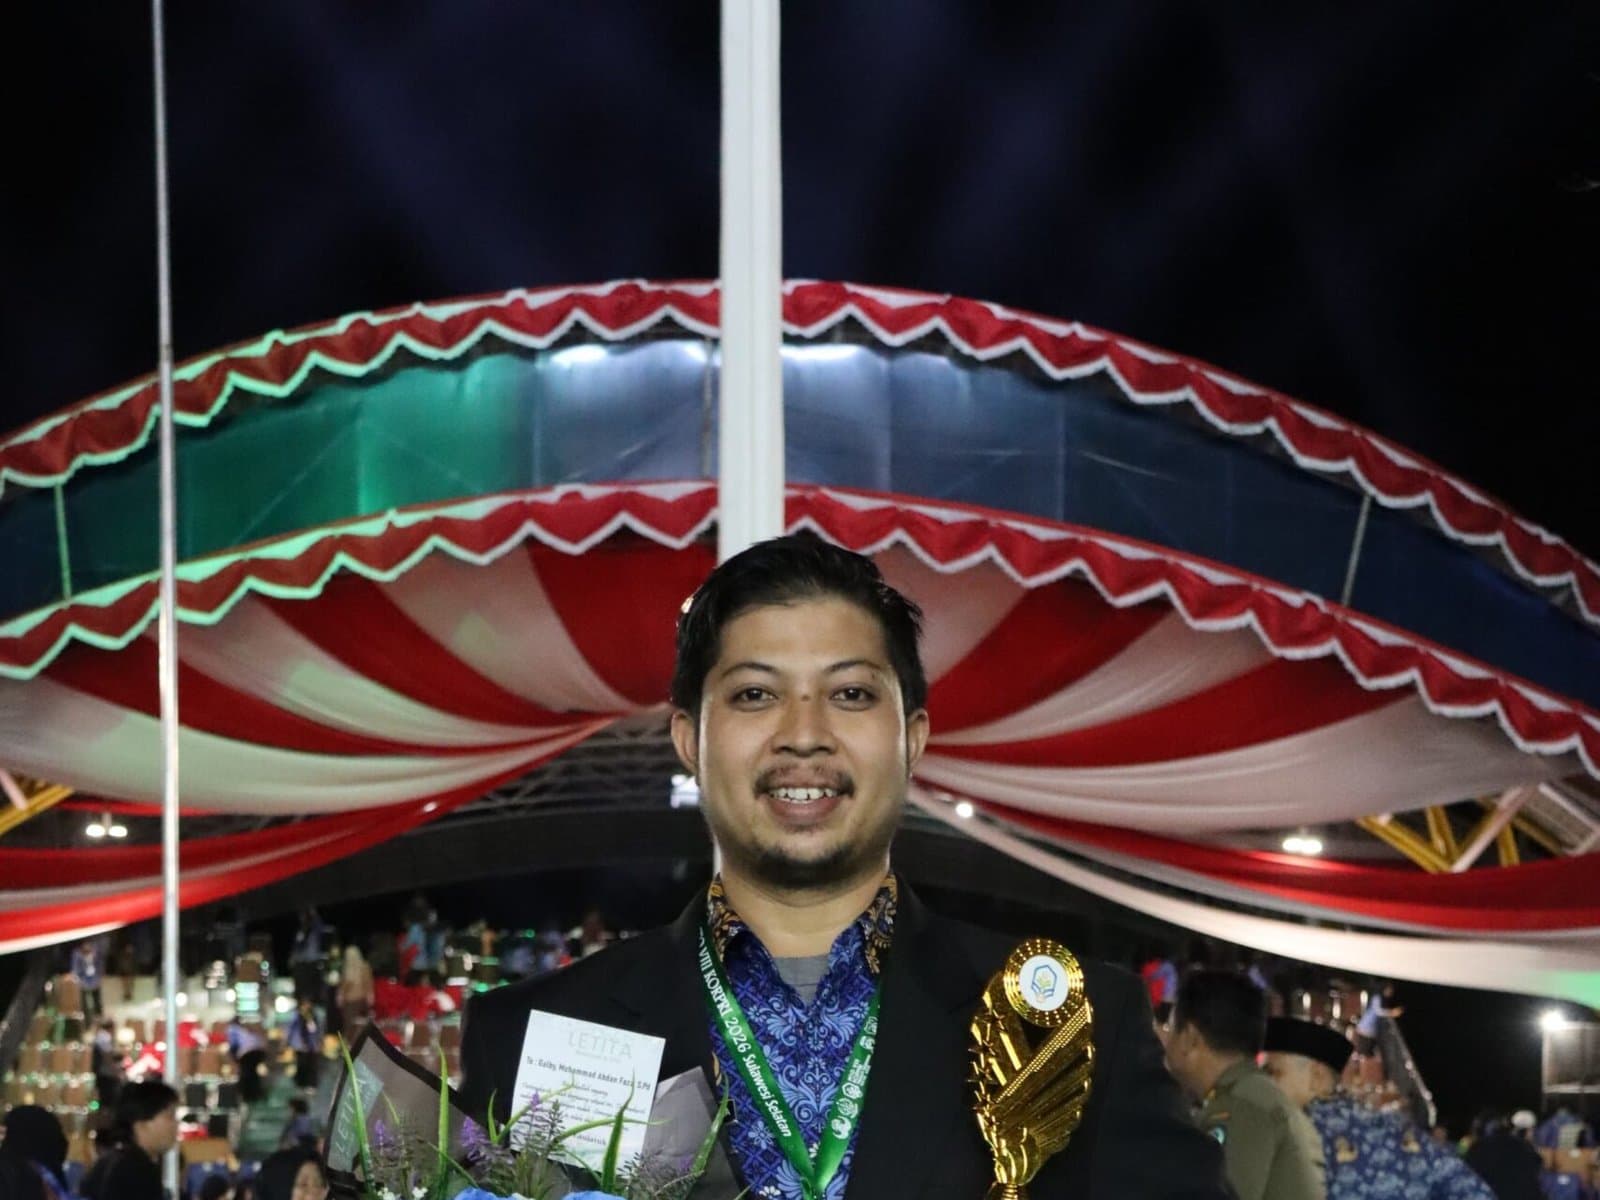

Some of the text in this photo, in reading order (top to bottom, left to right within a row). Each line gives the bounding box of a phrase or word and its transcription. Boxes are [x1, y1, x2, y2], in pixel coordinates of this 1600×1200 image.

[699, 946, 713, 972] VIII
[704, 968, 734, 1017] KORPRI
[567, 1031, 632, 1059] LETITA
[724, 1017, 752, 1053] 2026
[743, 1054, 776, 1100] Sulawesi
[764, 1100, 792, 1137] Selatan
